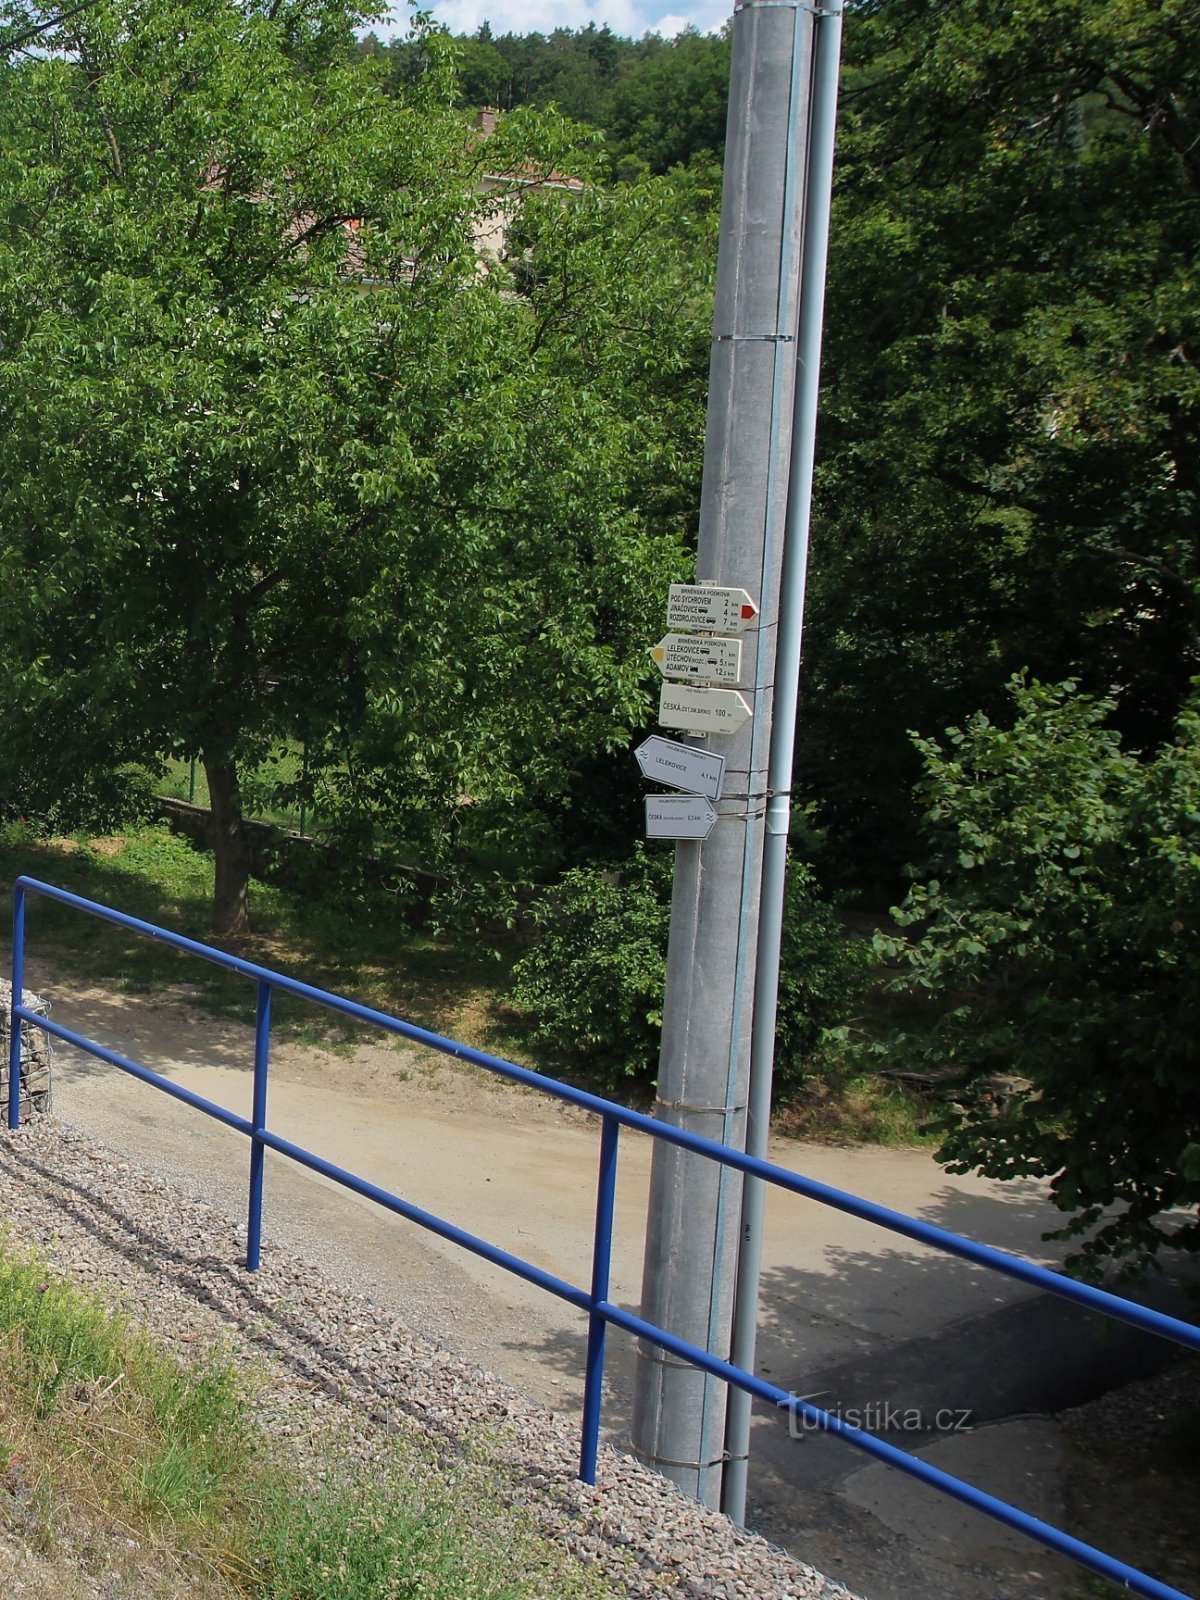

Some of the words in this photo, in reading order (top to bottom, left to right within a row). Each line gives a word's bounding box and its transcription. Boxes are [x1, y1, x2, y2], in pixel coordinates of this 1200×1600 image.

[671, 594, 681, 603] POD
[724, 599, 729, 607] 2
[670, 604, 698, 614] JINAČOVICE
[670, 613, 705, 624] ROZDROJOVICE
[667, 645, 700, 654] LELEKOVICE
[666, 663, 689, 672] ADAMOV
[662, 702, 681, 710] ČESKÁ
[715, 709, 726, 717] 100
[655, 756, 687, 772] LELEKOVICE
